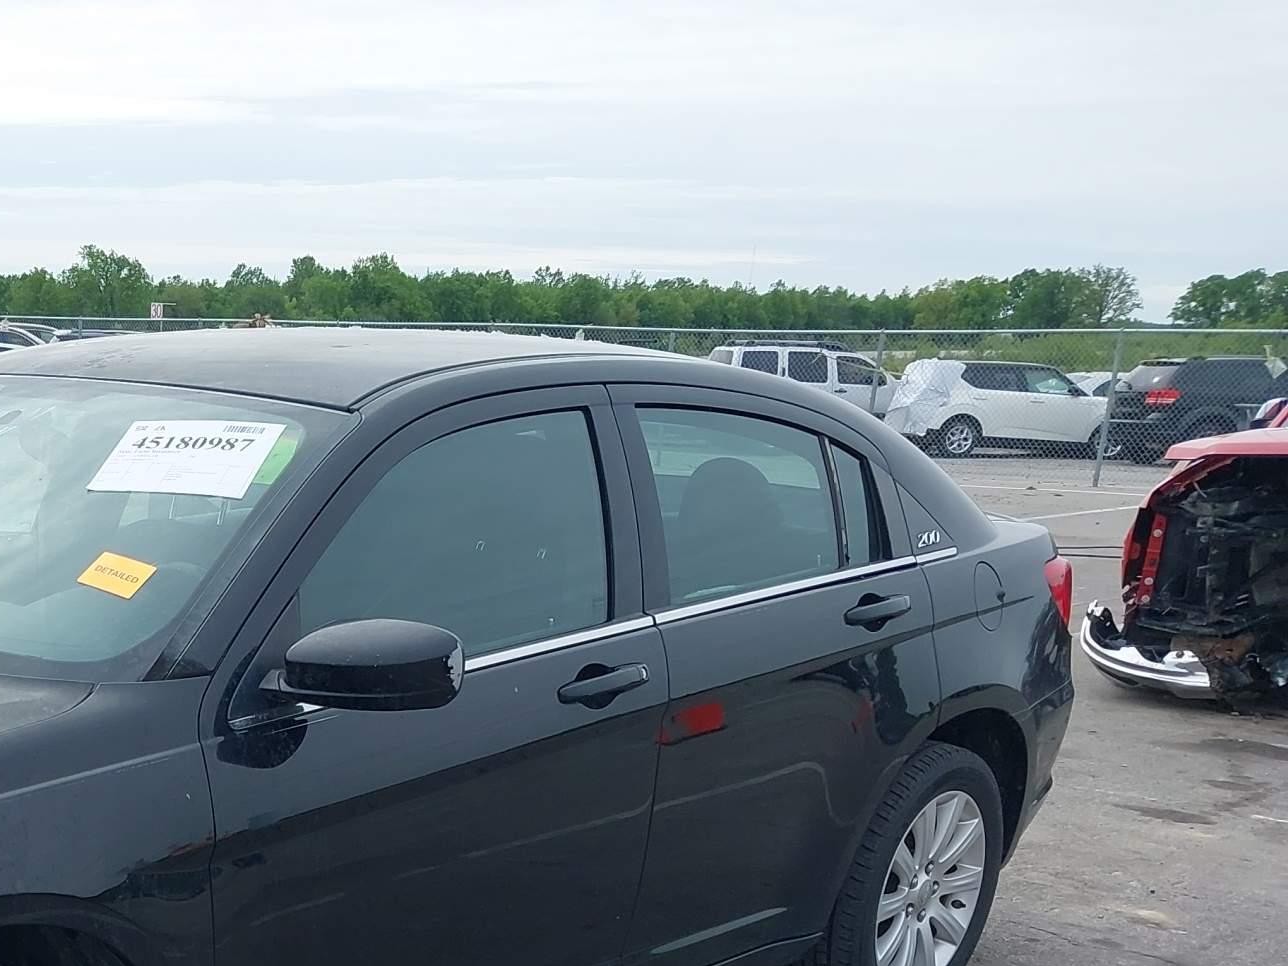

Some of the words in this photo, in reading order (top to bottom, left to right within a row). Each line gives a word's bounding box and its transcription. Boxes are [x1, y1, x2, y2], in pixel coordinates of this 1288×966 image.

[132, 436, 256, 453] 45180987
[917, 530, 941, 548] 200
[94, 565, 140, 584] DETAILED
